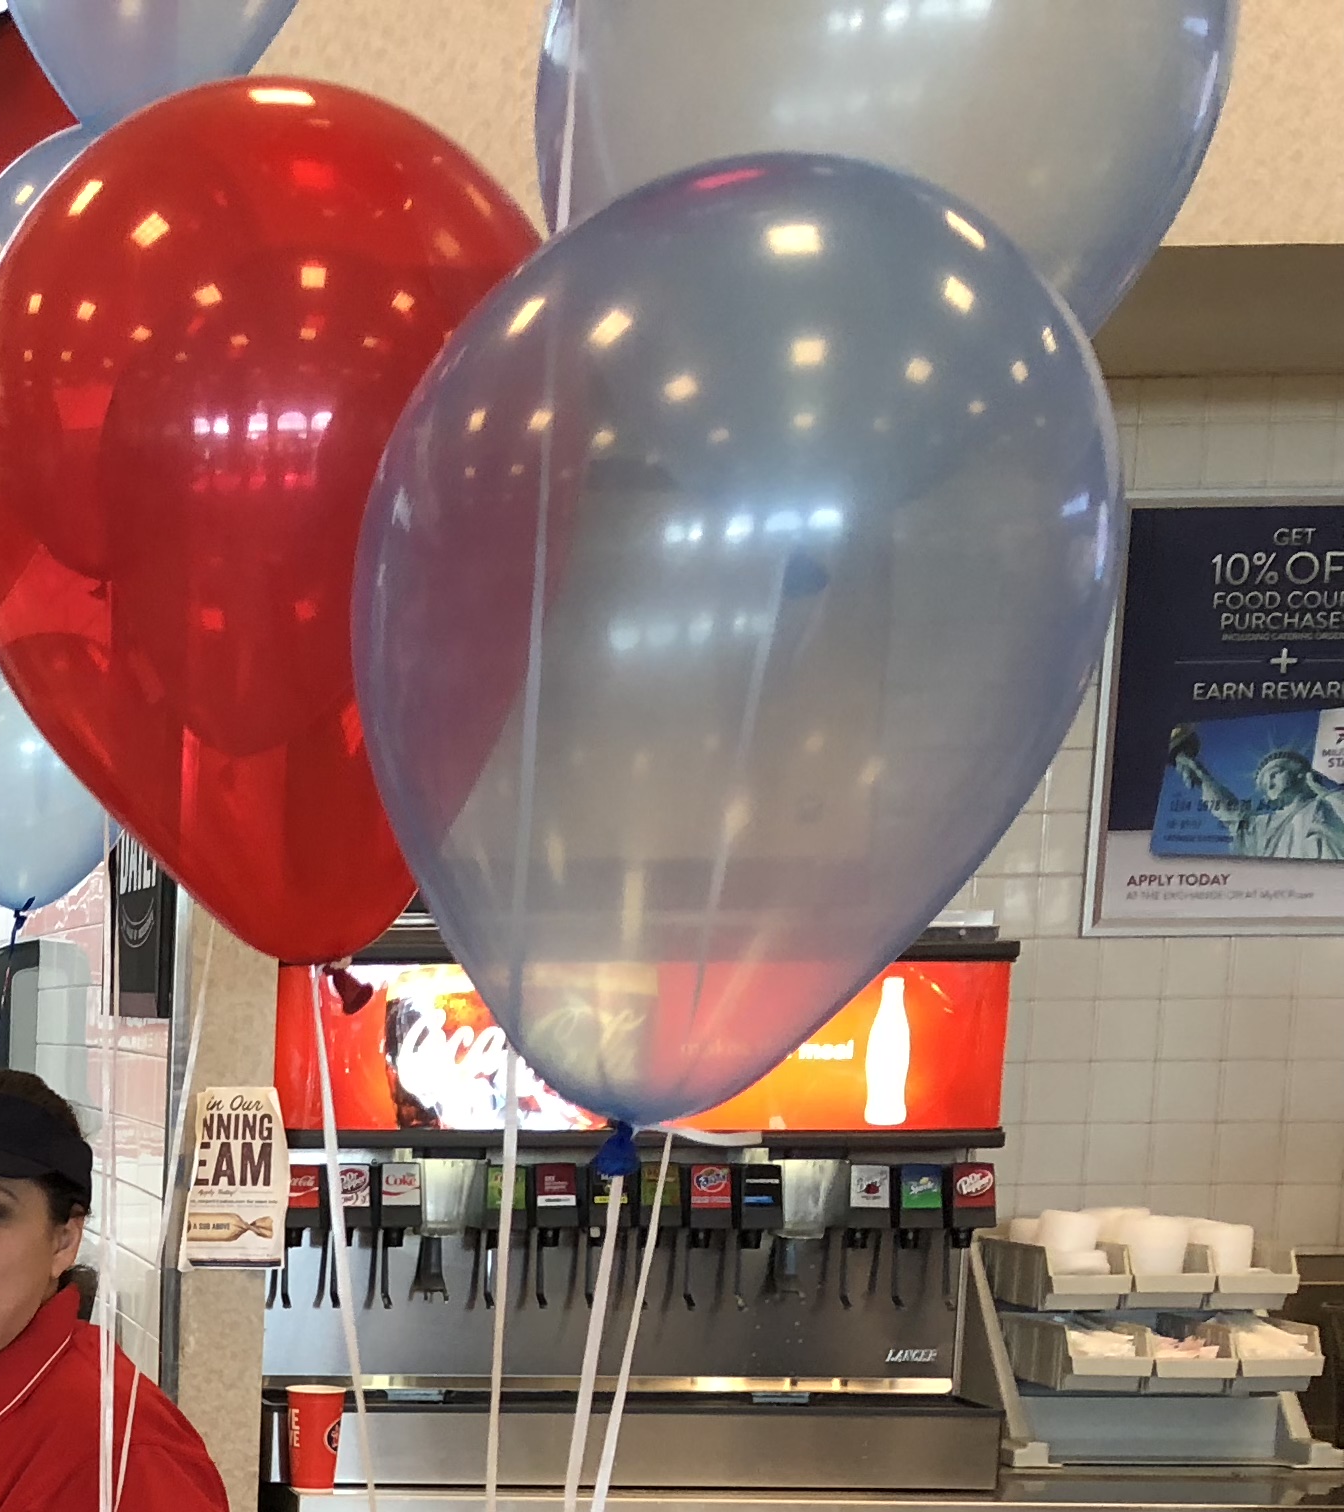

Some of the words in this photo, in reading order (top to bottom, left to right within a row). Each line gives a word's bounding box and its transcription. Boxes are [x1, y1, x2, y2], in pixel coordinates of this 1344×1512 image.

[1273, 527, 1317, 546] GET
[1211, 550, 1280, 587] 10%
[1285, 550, 1344, 587] OF
[1212, 590, 1281, 611] FOOD
[1192, 681, 1255, 701] EARN
[1261, 680, 1344, 700] REWAR
[1126, 873, 1175, 887] APPLY
[1175, 873, 1231, 887] TODAY
[206, 1096, 224, 1111] in
[229, 1095, 264, 1111] Our
[202, 1113, 273, 1141] NNING
[194, 1141, 272, 1187] EAM
[384, 1174, 417, 1188] Coke
